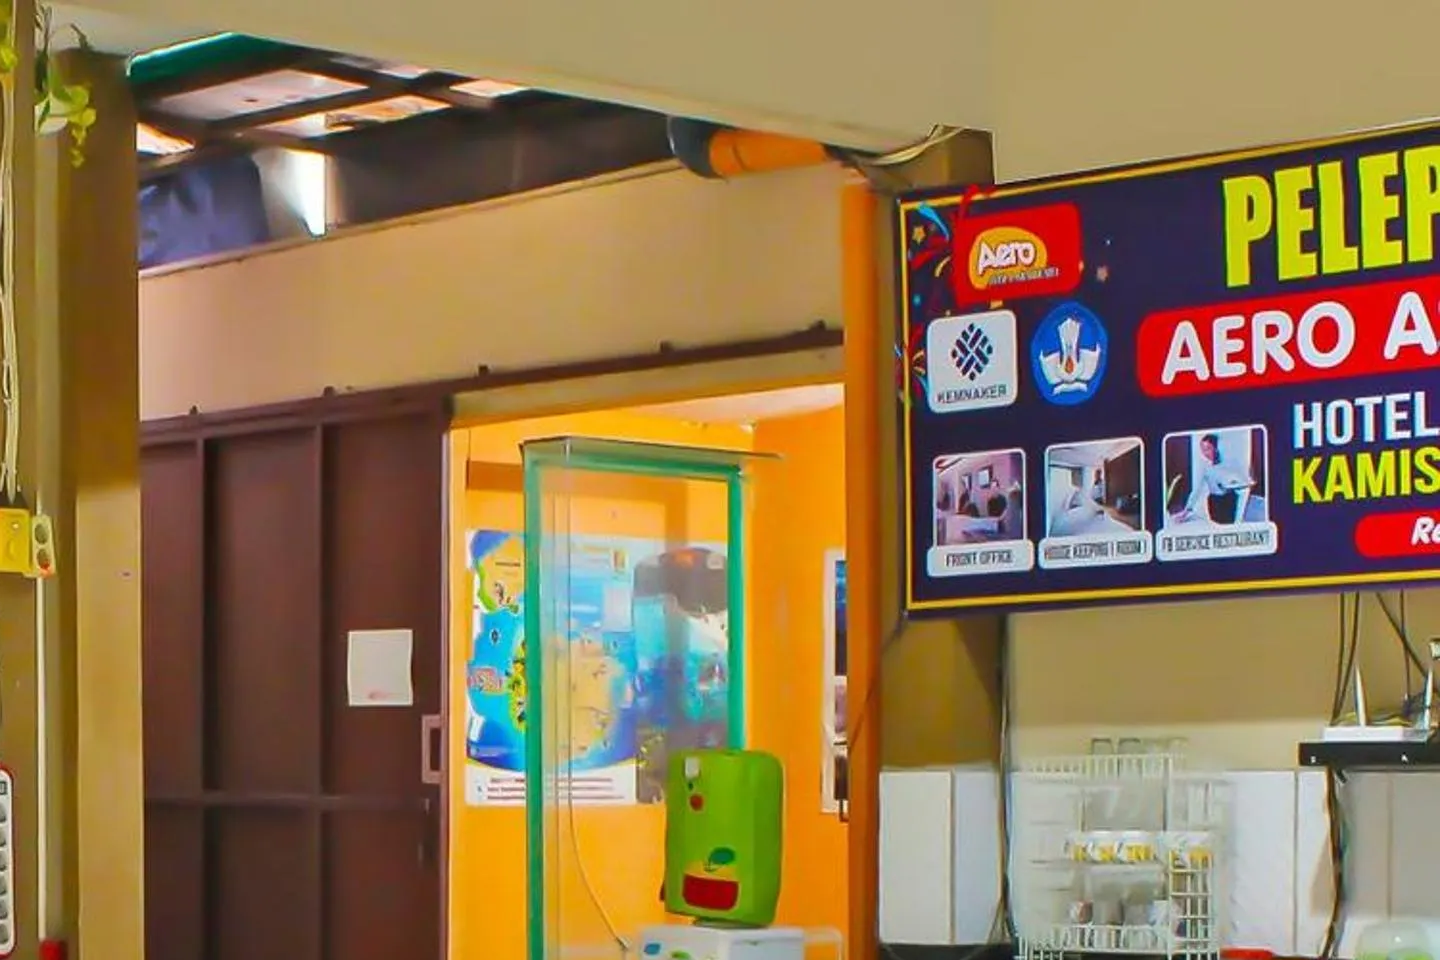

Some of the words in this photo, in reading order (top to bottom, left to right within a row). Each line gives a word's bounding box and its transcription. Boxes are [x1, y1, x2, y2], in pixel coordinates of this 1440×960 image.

[1222, 144, 1440, 288] PELEP
[977, 240, 1036, 275] Aero
[1161, 301, 1356, 385] AERO
[1383, 291, 1440, 360] A
[937, 383, 1007, 403] KEMNAKER
[1293, 391, 1440, 449] HOTEL
[1293, 446, 1440, 504] KAMIS
[946, 552, 977, 567] FRONT
[979, 549, 1013, 565] OFFICE
[1213, 530, 1269, 548] RESTAURANT
